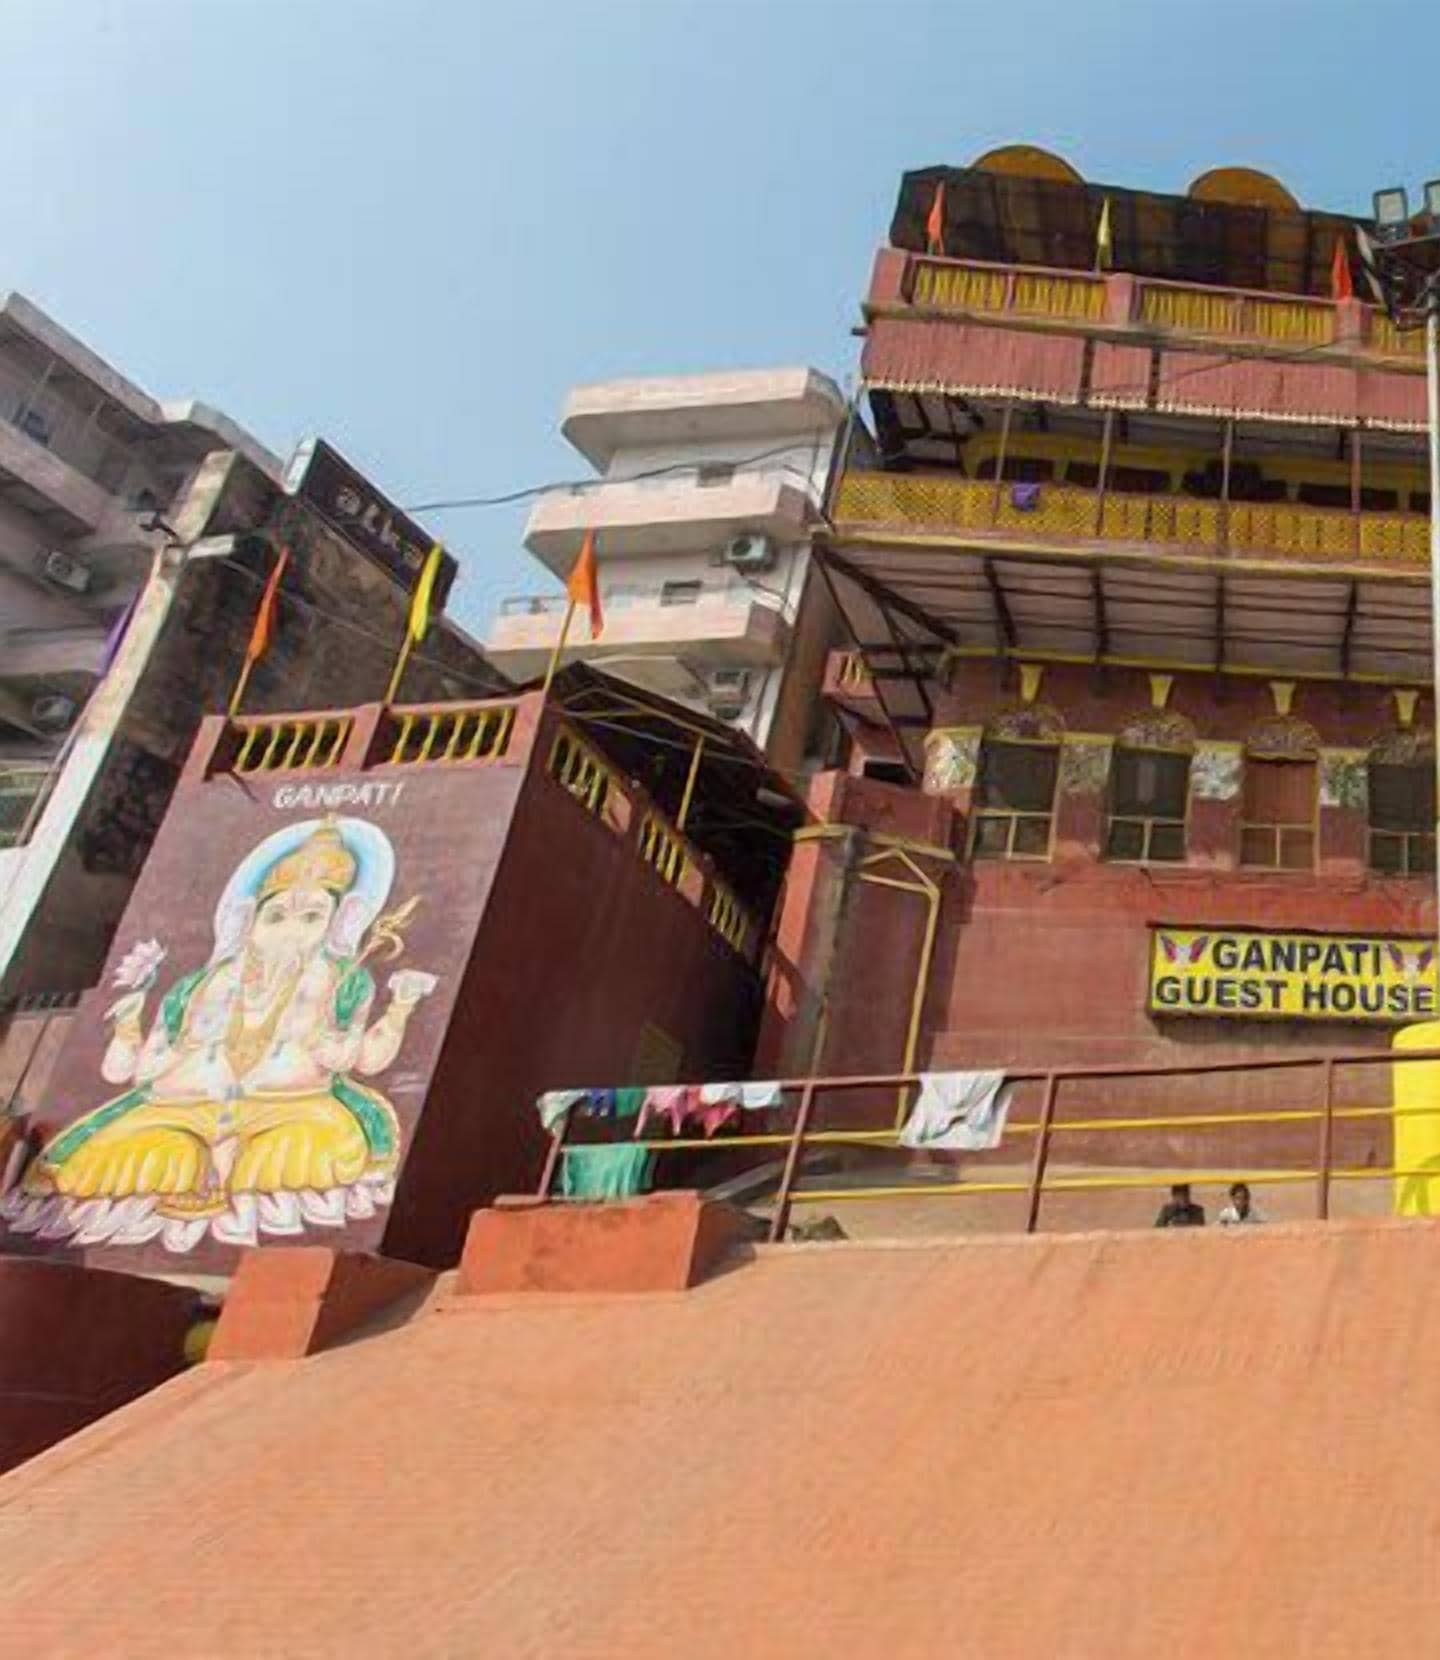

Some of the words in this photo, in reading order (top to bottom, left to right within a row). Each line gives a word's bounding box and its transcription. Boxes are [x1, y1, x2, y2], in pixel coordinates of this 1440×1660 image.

[272, 781, 406, 809] GANPATI
[1212, 939, 1381, 976] GANPATI
[1155, 975, 1288, 1009] GUEST
[1303, 981, 1434, 1013] HOUSE
